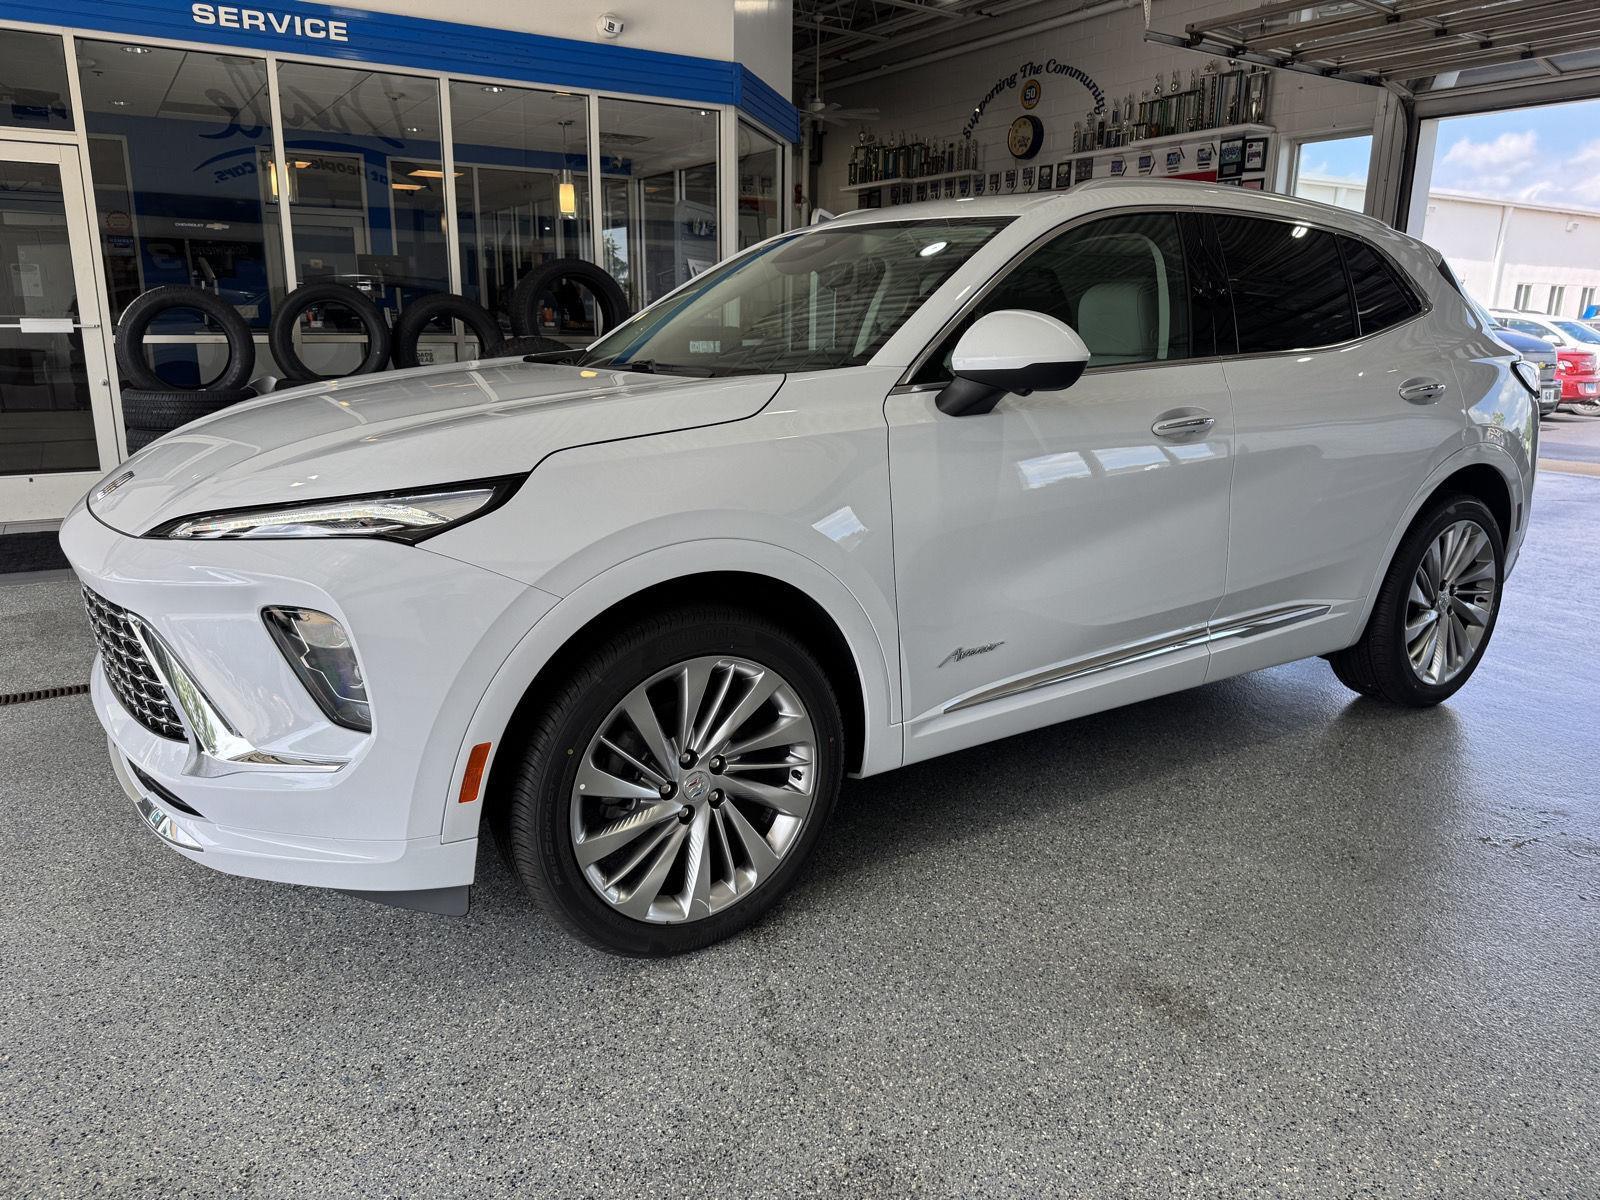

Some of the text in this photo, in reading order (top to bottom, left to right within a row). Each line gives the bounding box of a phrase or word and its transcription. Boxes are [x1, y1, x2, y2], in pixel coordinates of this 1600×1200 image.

[191, 3, 348, 42] SERVICE
[963, 72, 1018, 140] Supporting
[1020, 61, 1043, 80] The
[1045, 58, 1106, 115] Community
[1025, 87, 1036, 99] 50
